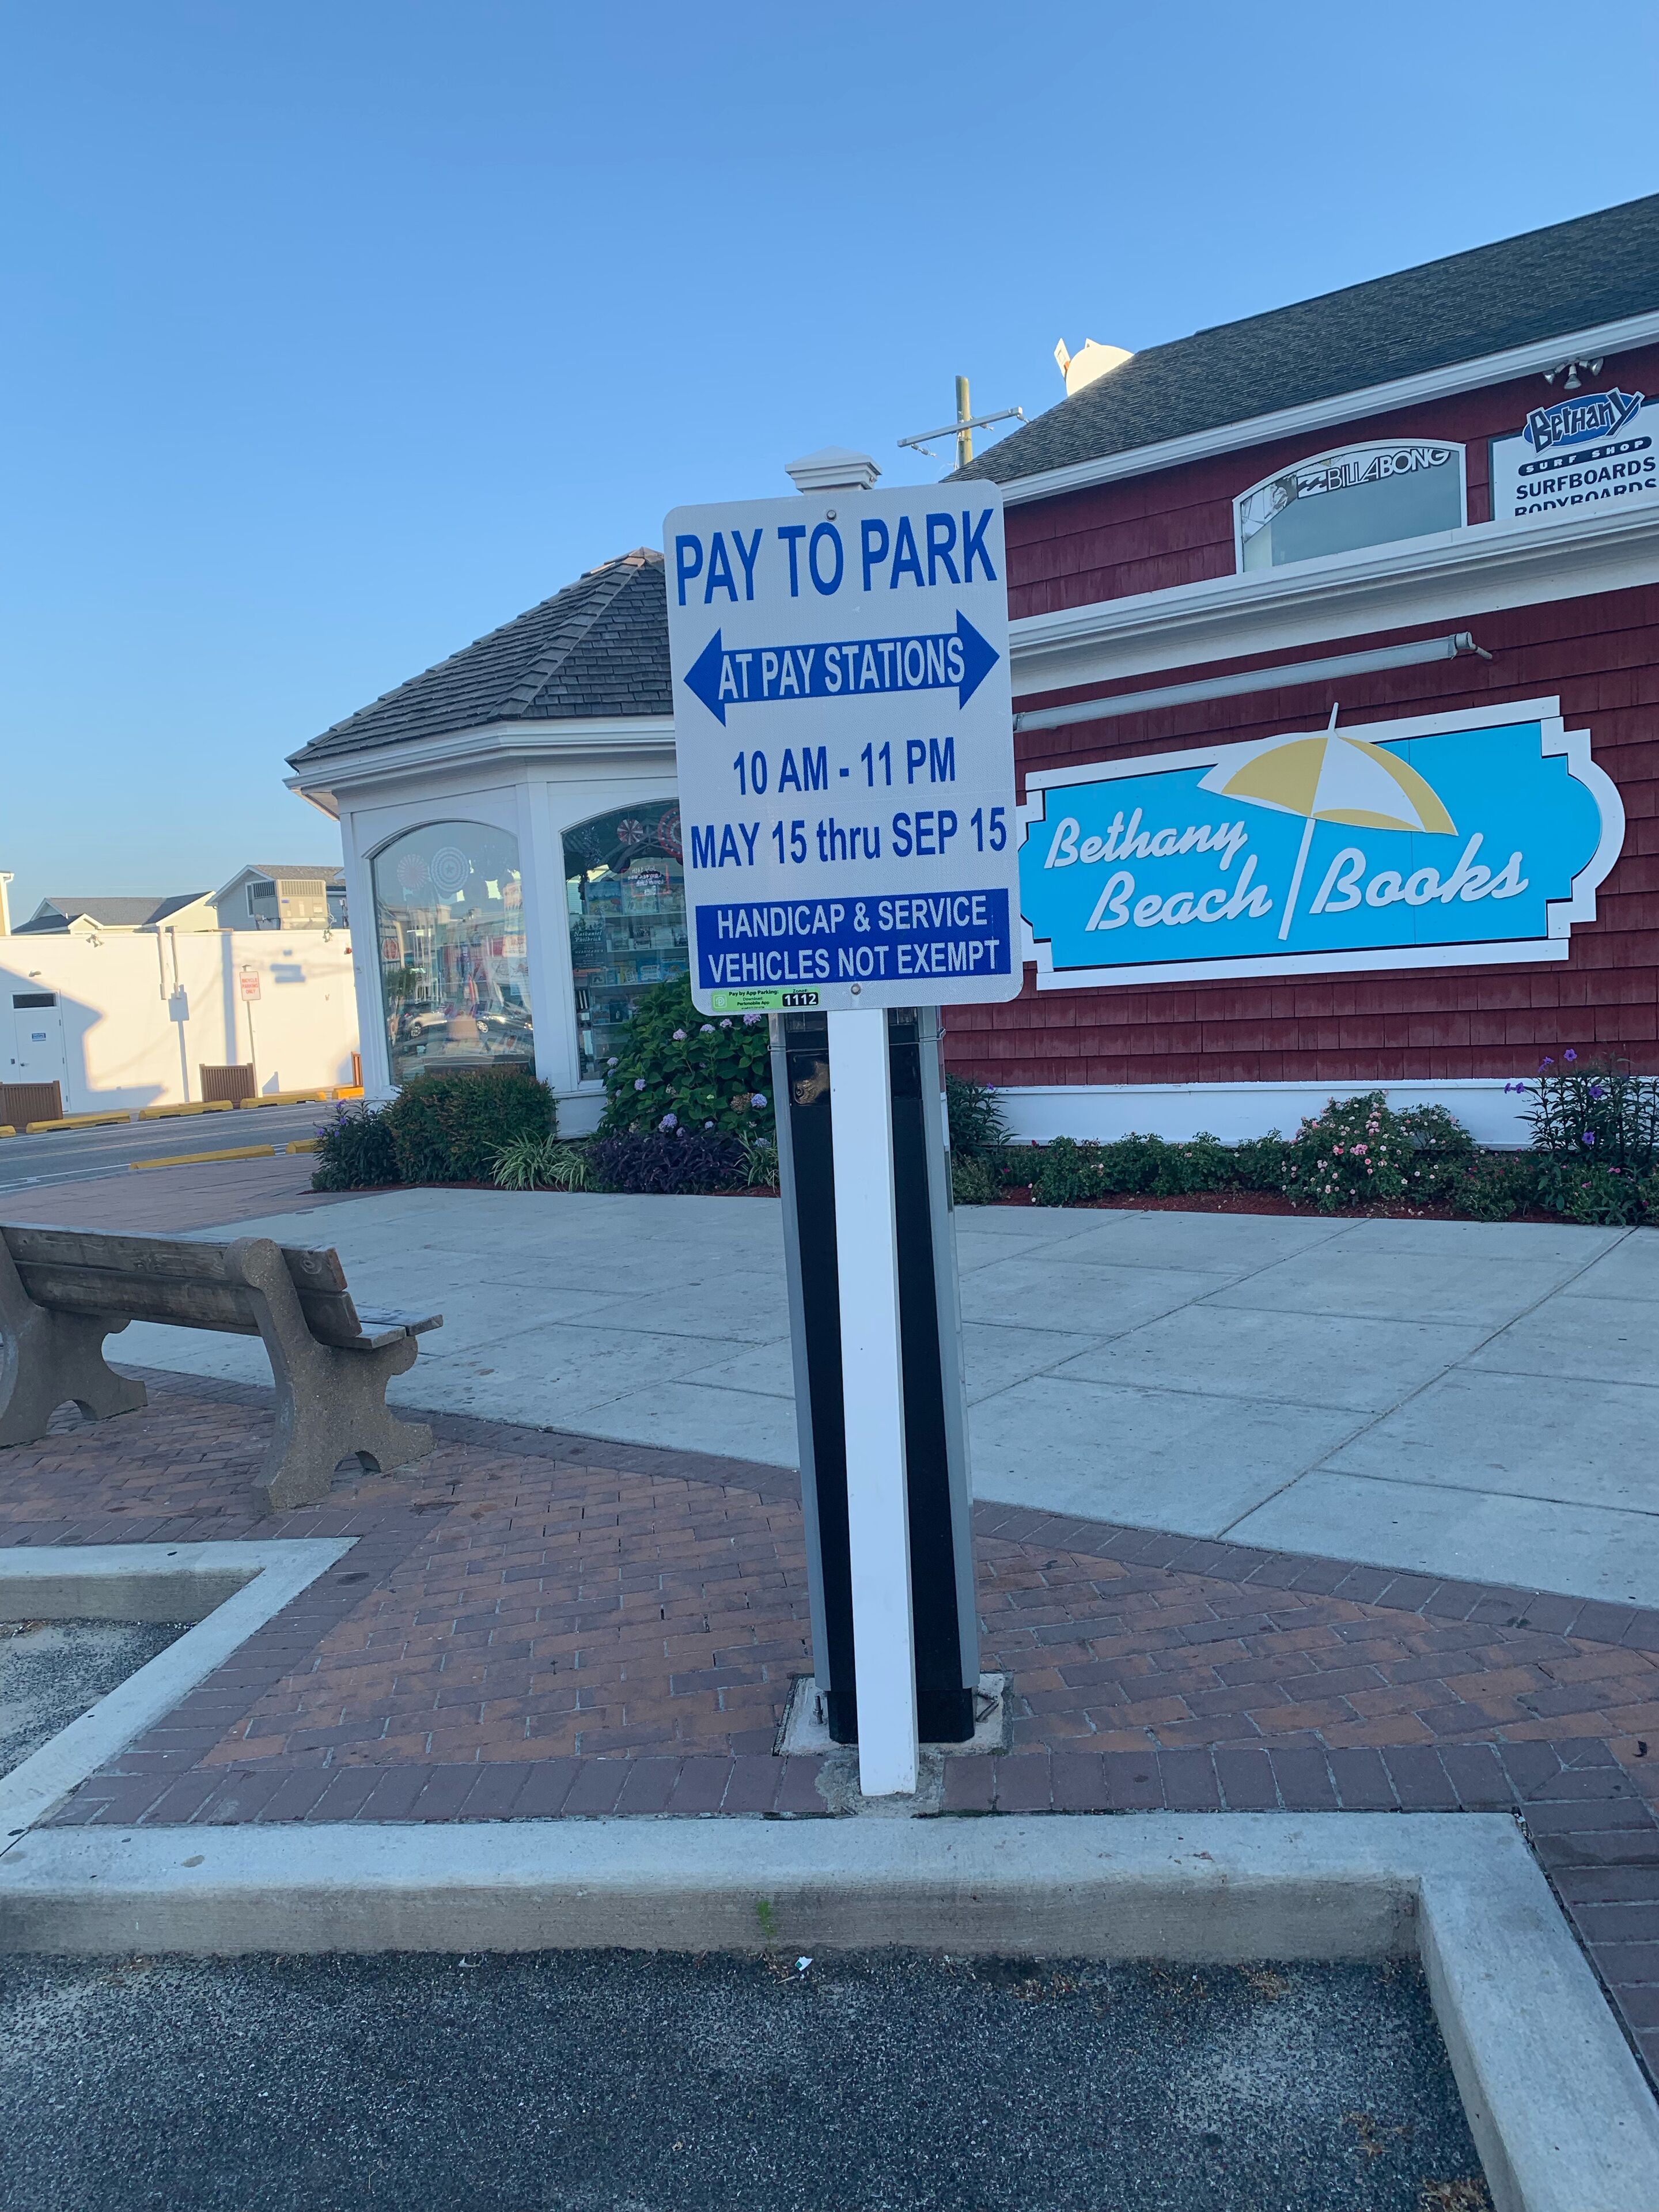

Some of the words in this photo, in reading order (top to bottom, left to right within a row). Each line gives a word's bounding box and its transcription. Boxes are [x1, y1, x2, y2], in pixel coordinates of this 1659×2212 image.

[1327, 449, 1451, 490] BILLABONG
[1516, 456, 1656, 499] SURFBOARDS
[1527, 455, 1577, 473] SURF
[1592, 440, 1643, 458] SHOP
[675, 528, 763, 606] PAY
[778, 522, 844, 597] TO
[861, 509, 997, 592] PARK
[718, 653, 749, 700] AT
[762, 648, 815, 696] PAY
[824, 637, 965, 693] STATIONS
[734, 751, 767, 795] 10
[778, 746, 828, 793] AM
[839, 767, 849, 777] -
[861, 741, 891, 787] 11
[907, 737, 955, 784] PM
[691, 822, 760, 869] MAY
[772, 820, 806, 864] 15
[817, 817, 880, 861] thru
[892, 810, 957, 857] SEP
[971, 806, 1006, 852] 15
[1044, 808, 1248, 870] Bethany
[1085, 854, 1272, 931] Beach
[1309, 832, 1529, 914] Books
[717, 903, 845, 939] HANDICAP
[854, 902, 870, 932] &
[878, 895, 987, 930] SERVICE
[709, 948, 830, 983] VEHICLES
[838, 945, 889, 977] NOT
[897, 940, 999, 974] EXEMPT
[784, 994, 817, 1006] 1112
